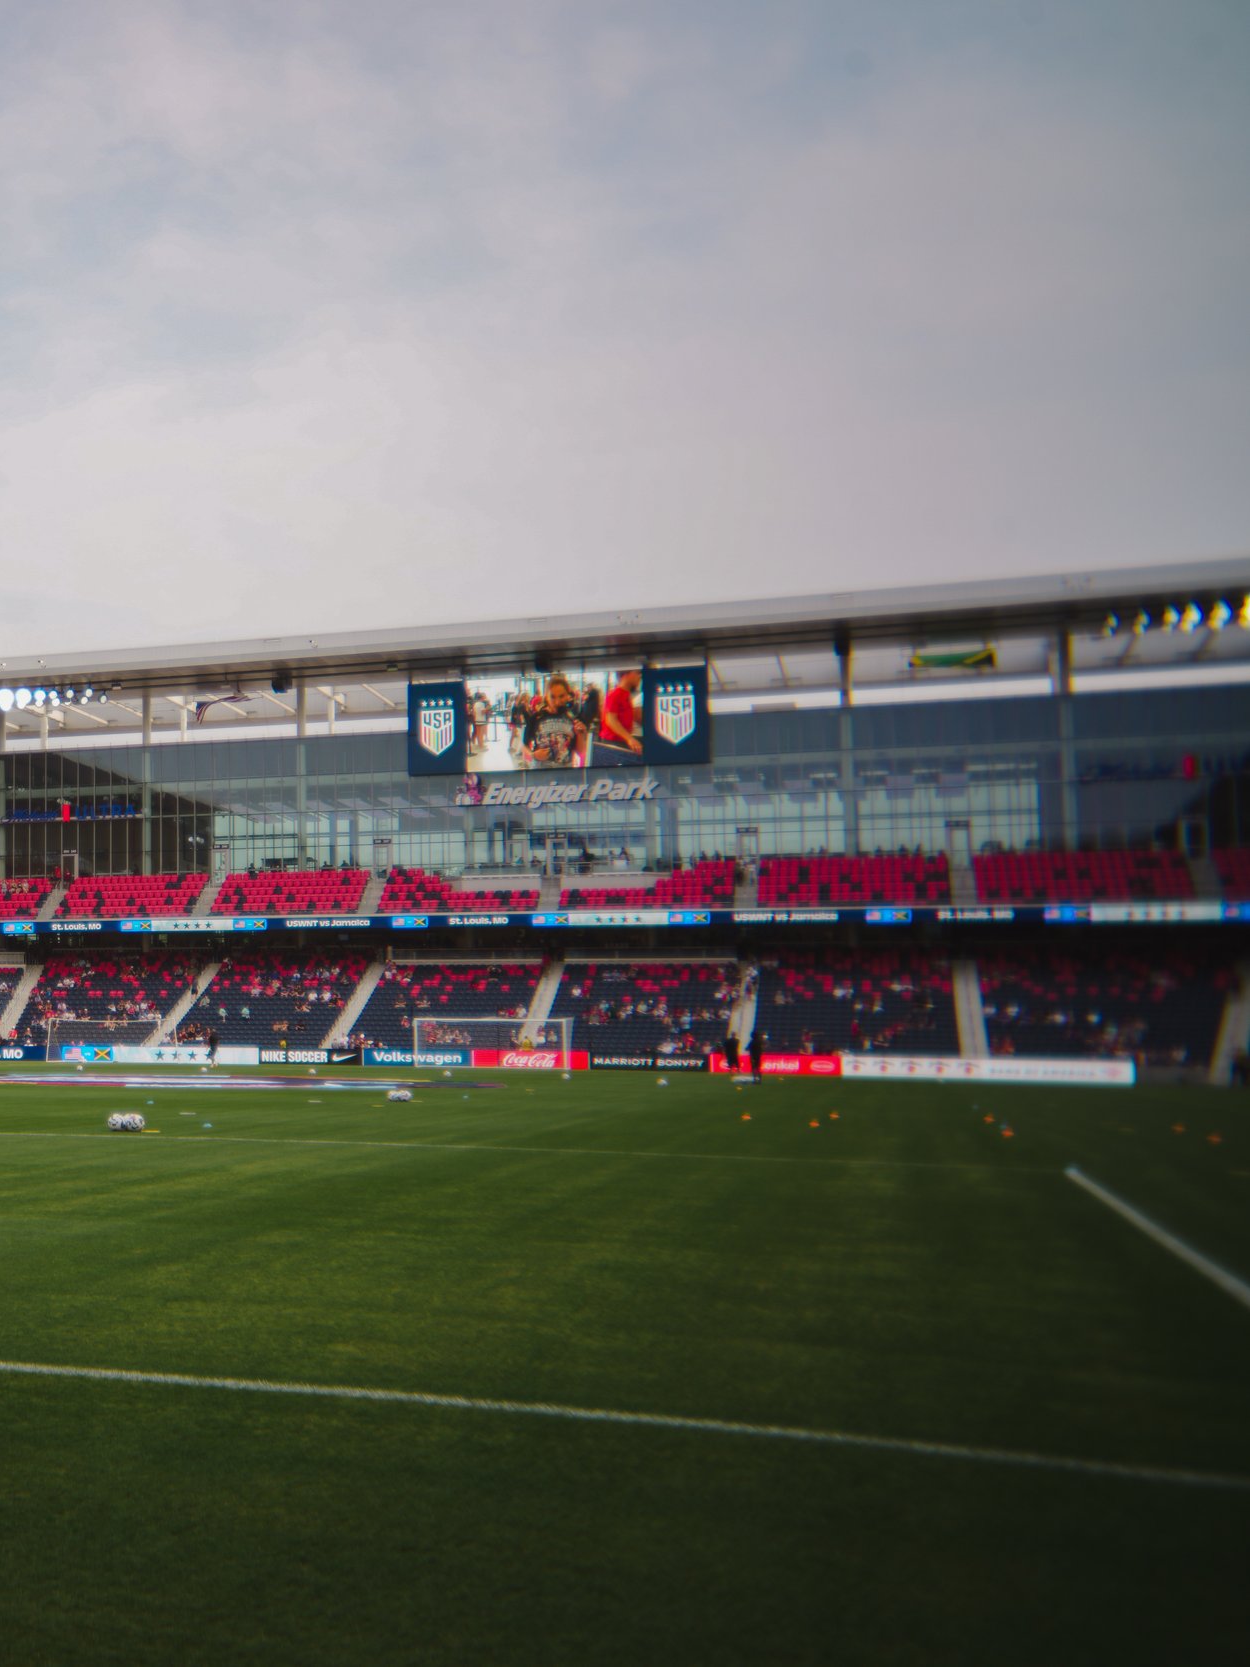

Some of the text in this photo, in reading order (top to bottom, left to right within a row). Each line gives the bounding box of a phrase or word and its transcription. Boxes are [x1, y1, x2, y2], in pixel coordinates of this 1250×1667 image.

[658, 697, 692, 715] USA
[422, 710, 452, 728] USA
[482, 778, 660, 808] Energizer Park
[733, 911, 838, 921] USWNT vs Jamaica
[286, 919, 318, 927] USWNT
[331, 918, 370, 927] Jamaica
[3, 1048, 23, 1059] MO
[261, 1051, 327, 1062] NIKE SOCCER
[372, 1051, 462, 1065] Volkswagen
[593, 1056, 653, 1066] MARRIOTT
[763, 1059, 800, 1070] enkel
